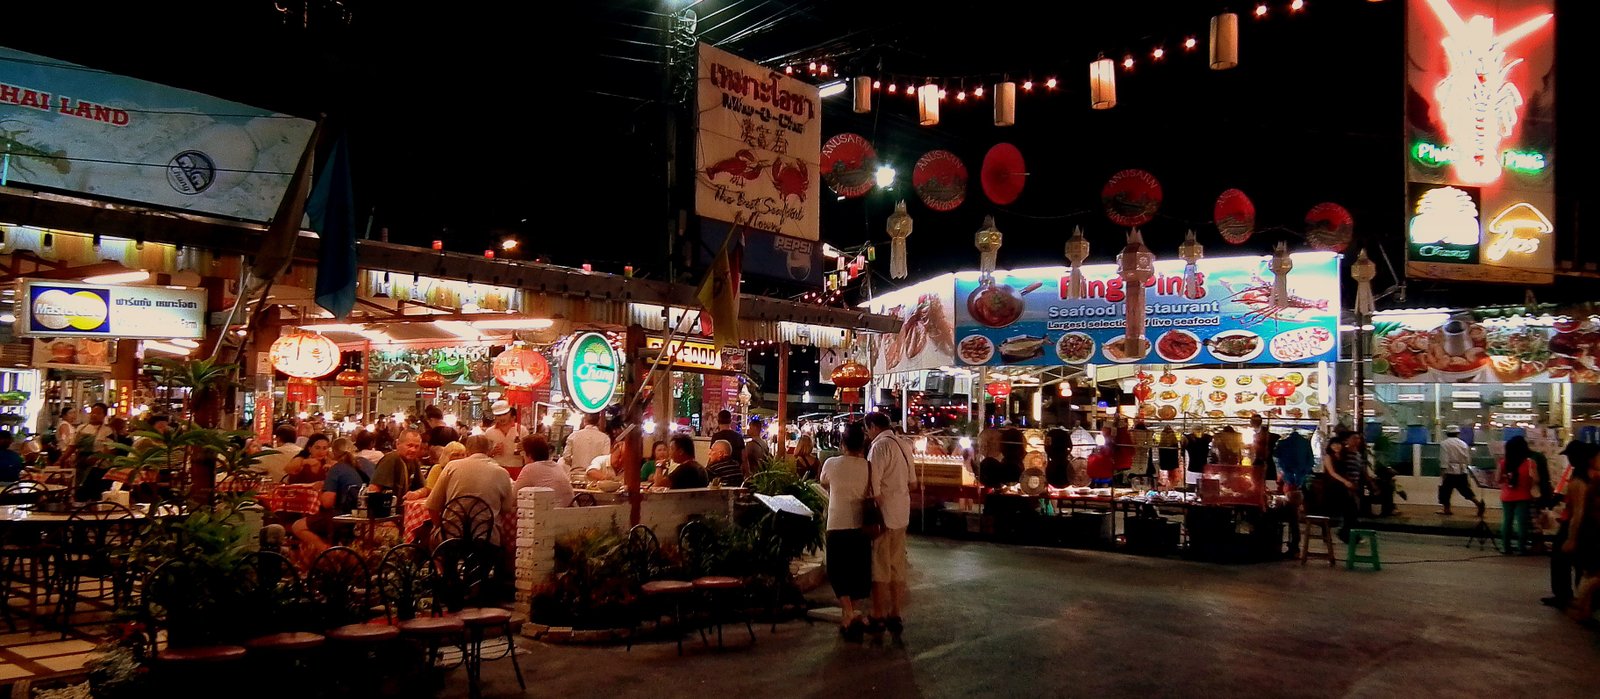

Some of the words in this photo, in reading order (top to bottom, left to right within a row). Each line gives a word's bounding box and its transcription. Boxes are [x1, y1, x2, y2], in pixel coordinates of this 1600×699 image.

[60, 97, 129, 125] LAND
[714, 184, 735, 204] The
[737, 192, 761, 210] Best
[776, 235, 812, 255] PEPSI
[1048, 303, 1116, 318] Seafood
[1122, 300, 1219, 315] staurant
[1047, 320, 1086, 331] Largest
[1088, 318, 1128, 329] selectio
[1152, 317, 1172, 326] live
[1175, 316, 1219, 326] seafood
[721, 347, 746, 356] PEPSI
